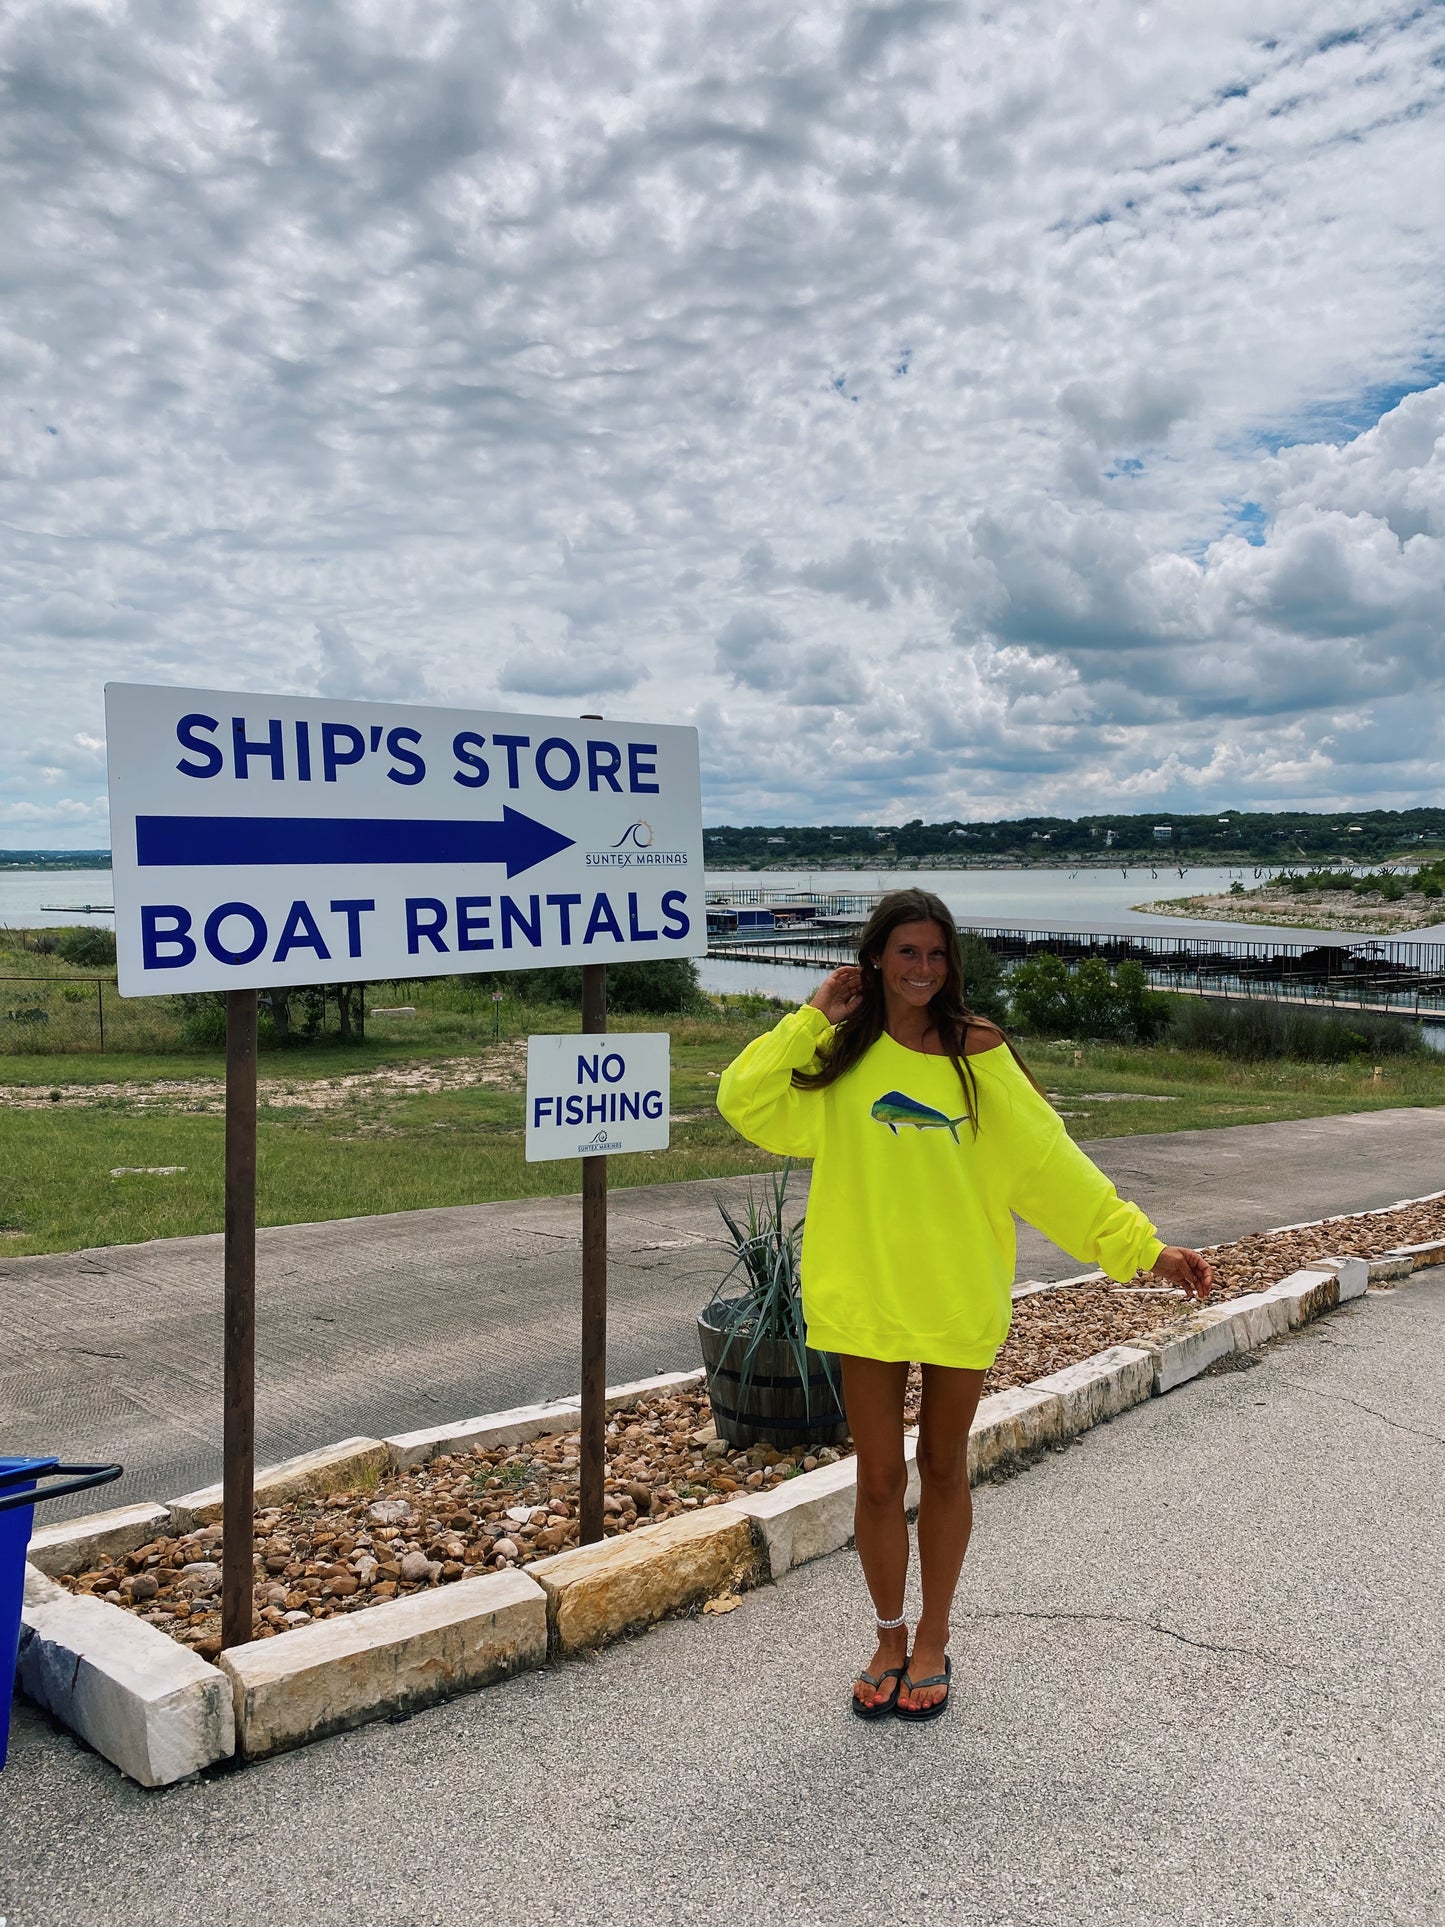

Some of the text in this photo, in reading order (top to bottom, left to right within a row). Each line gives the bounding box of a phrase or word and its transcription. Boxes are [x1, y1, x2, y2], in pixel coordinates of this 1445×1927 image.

[176, 713, 660, 794] SHIP'S STORE
[585, 854, 688, 867] SUNTEX MARINAS
[140, 890, 690, 970] BOAT RENTALS
[577, 1053, 625, 1084] NO
[533, 1090, 663, 1128] FISHING
